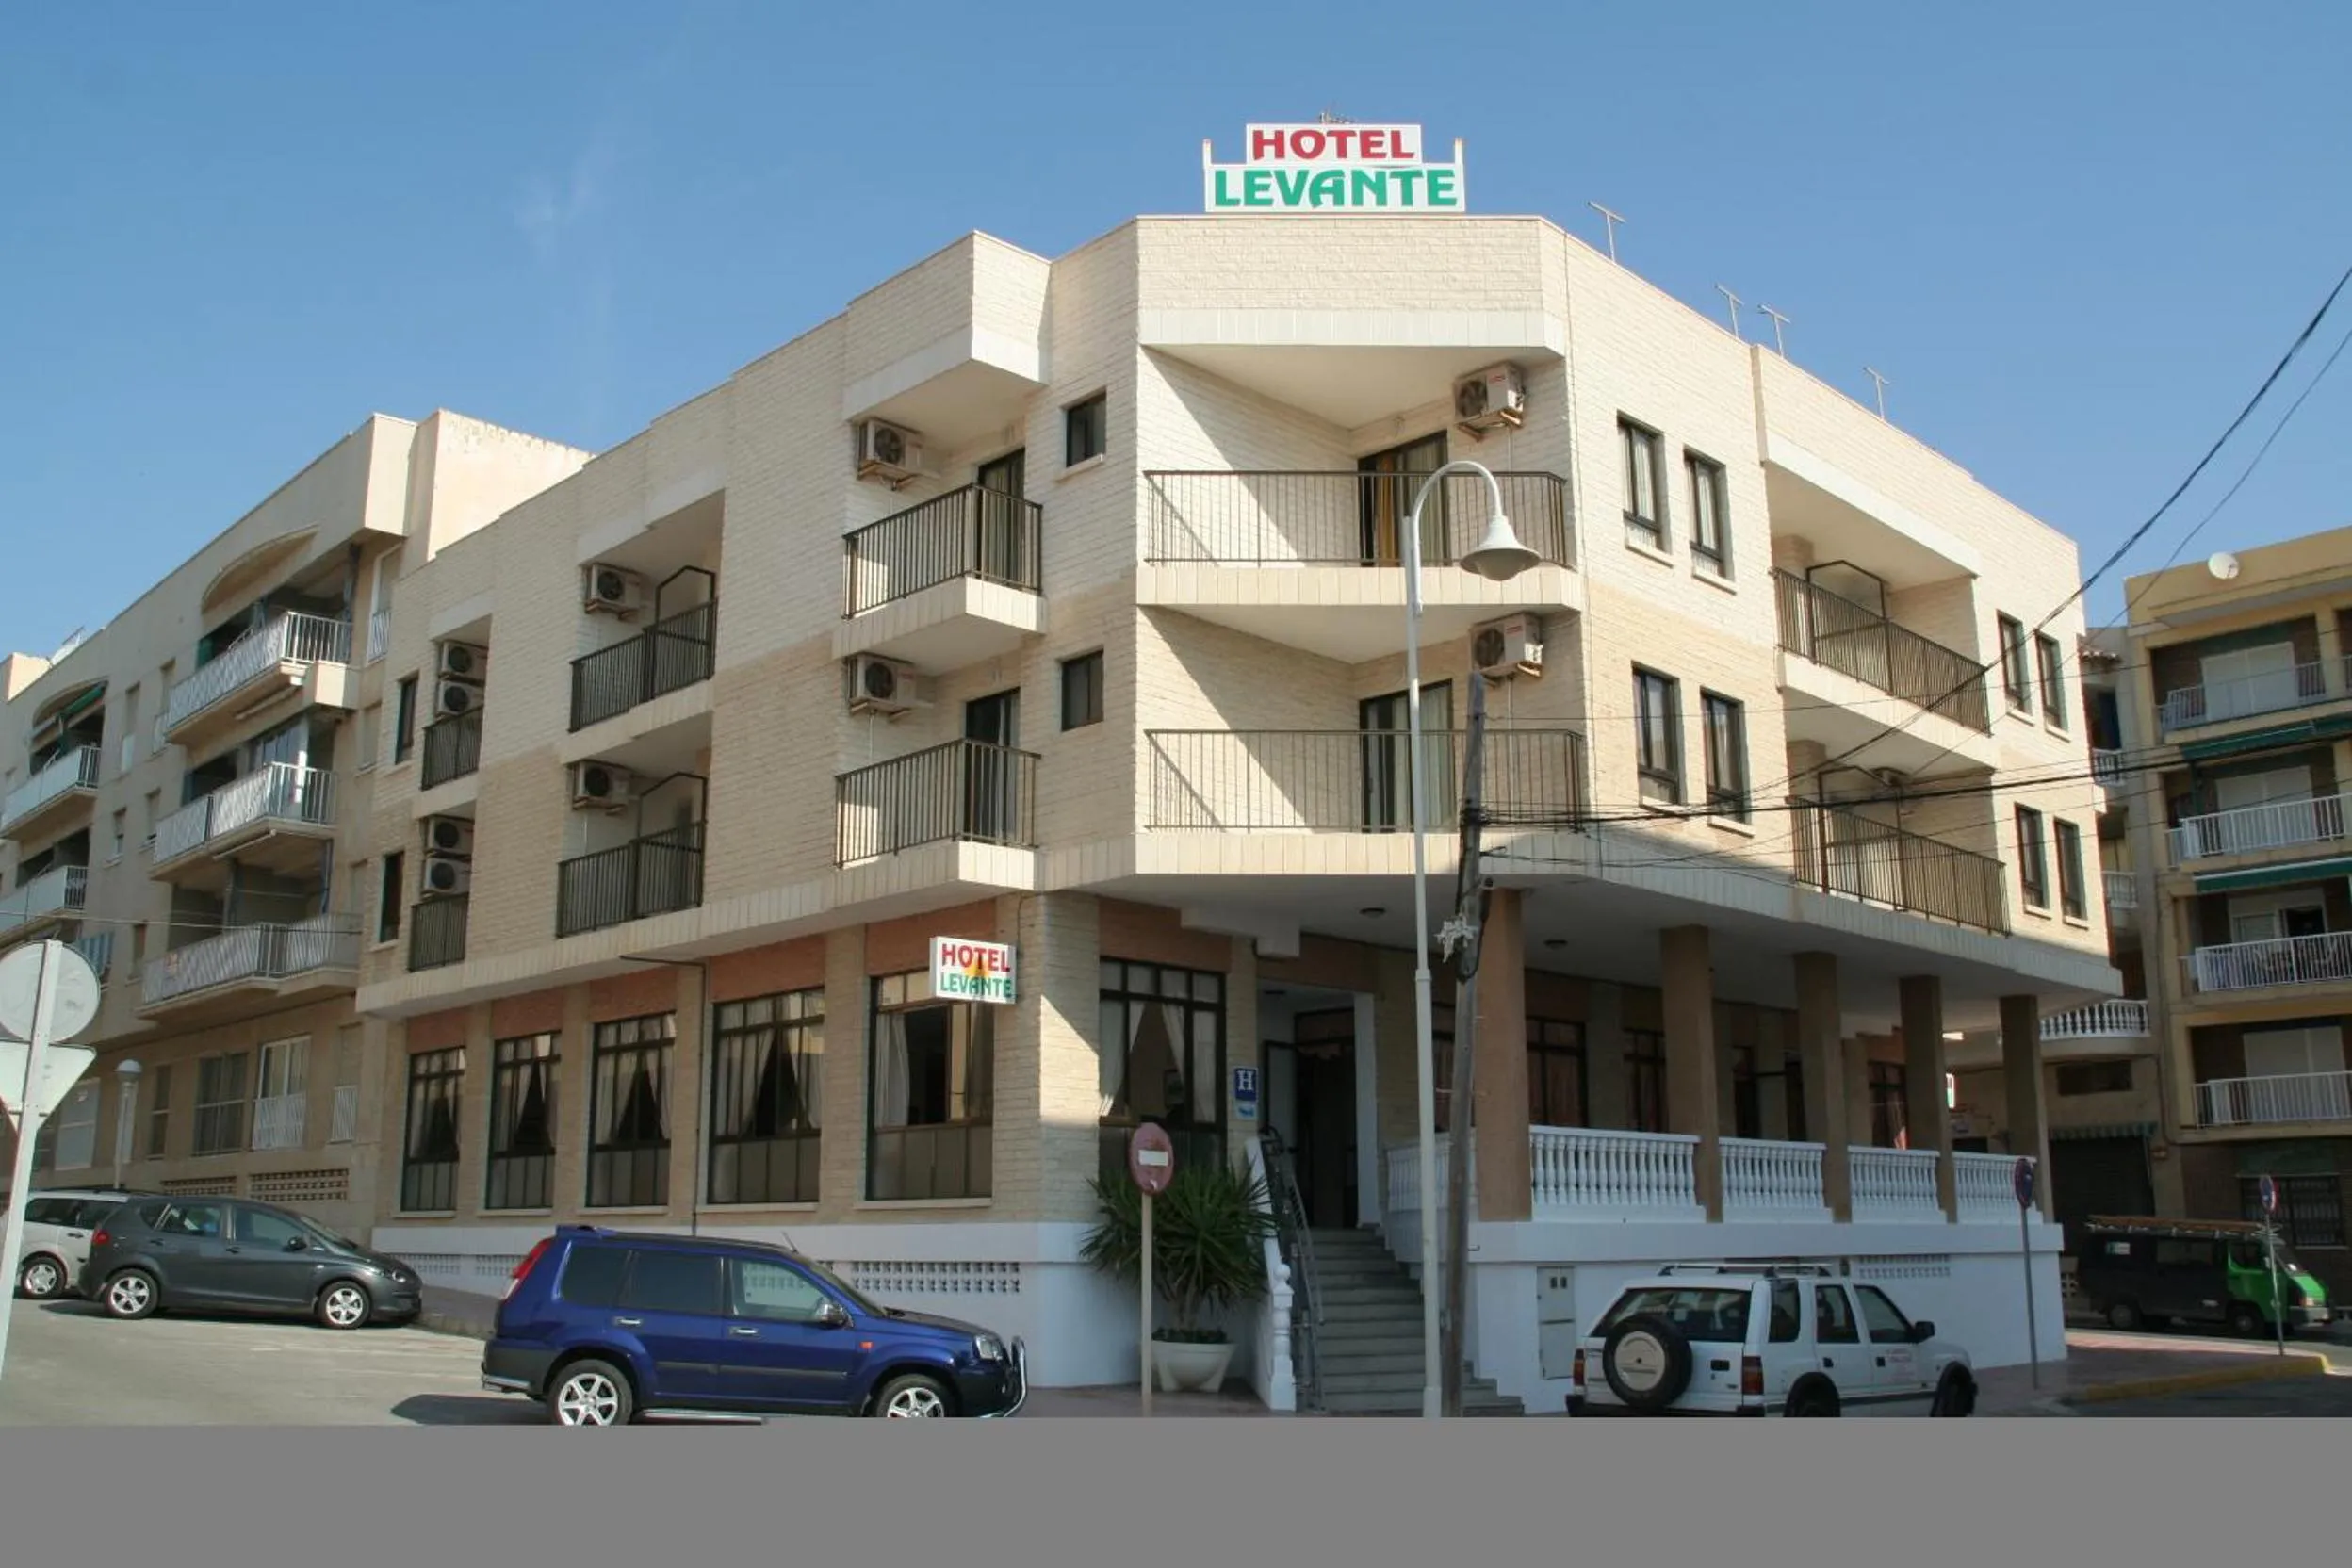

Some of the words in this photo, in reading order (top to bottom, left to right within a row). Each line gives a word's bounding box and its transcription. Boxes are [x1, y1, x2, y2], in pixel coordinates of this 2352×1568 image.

[1252, 129, 1414, 160] HOTEL
[1215, 169, 1457, 208] LEVANTE
[941, 943, 1010, 972] HOTEL
[940, 972, 1012, 998] LEVANTE
[1236, 1070, 1254, 1091] H
